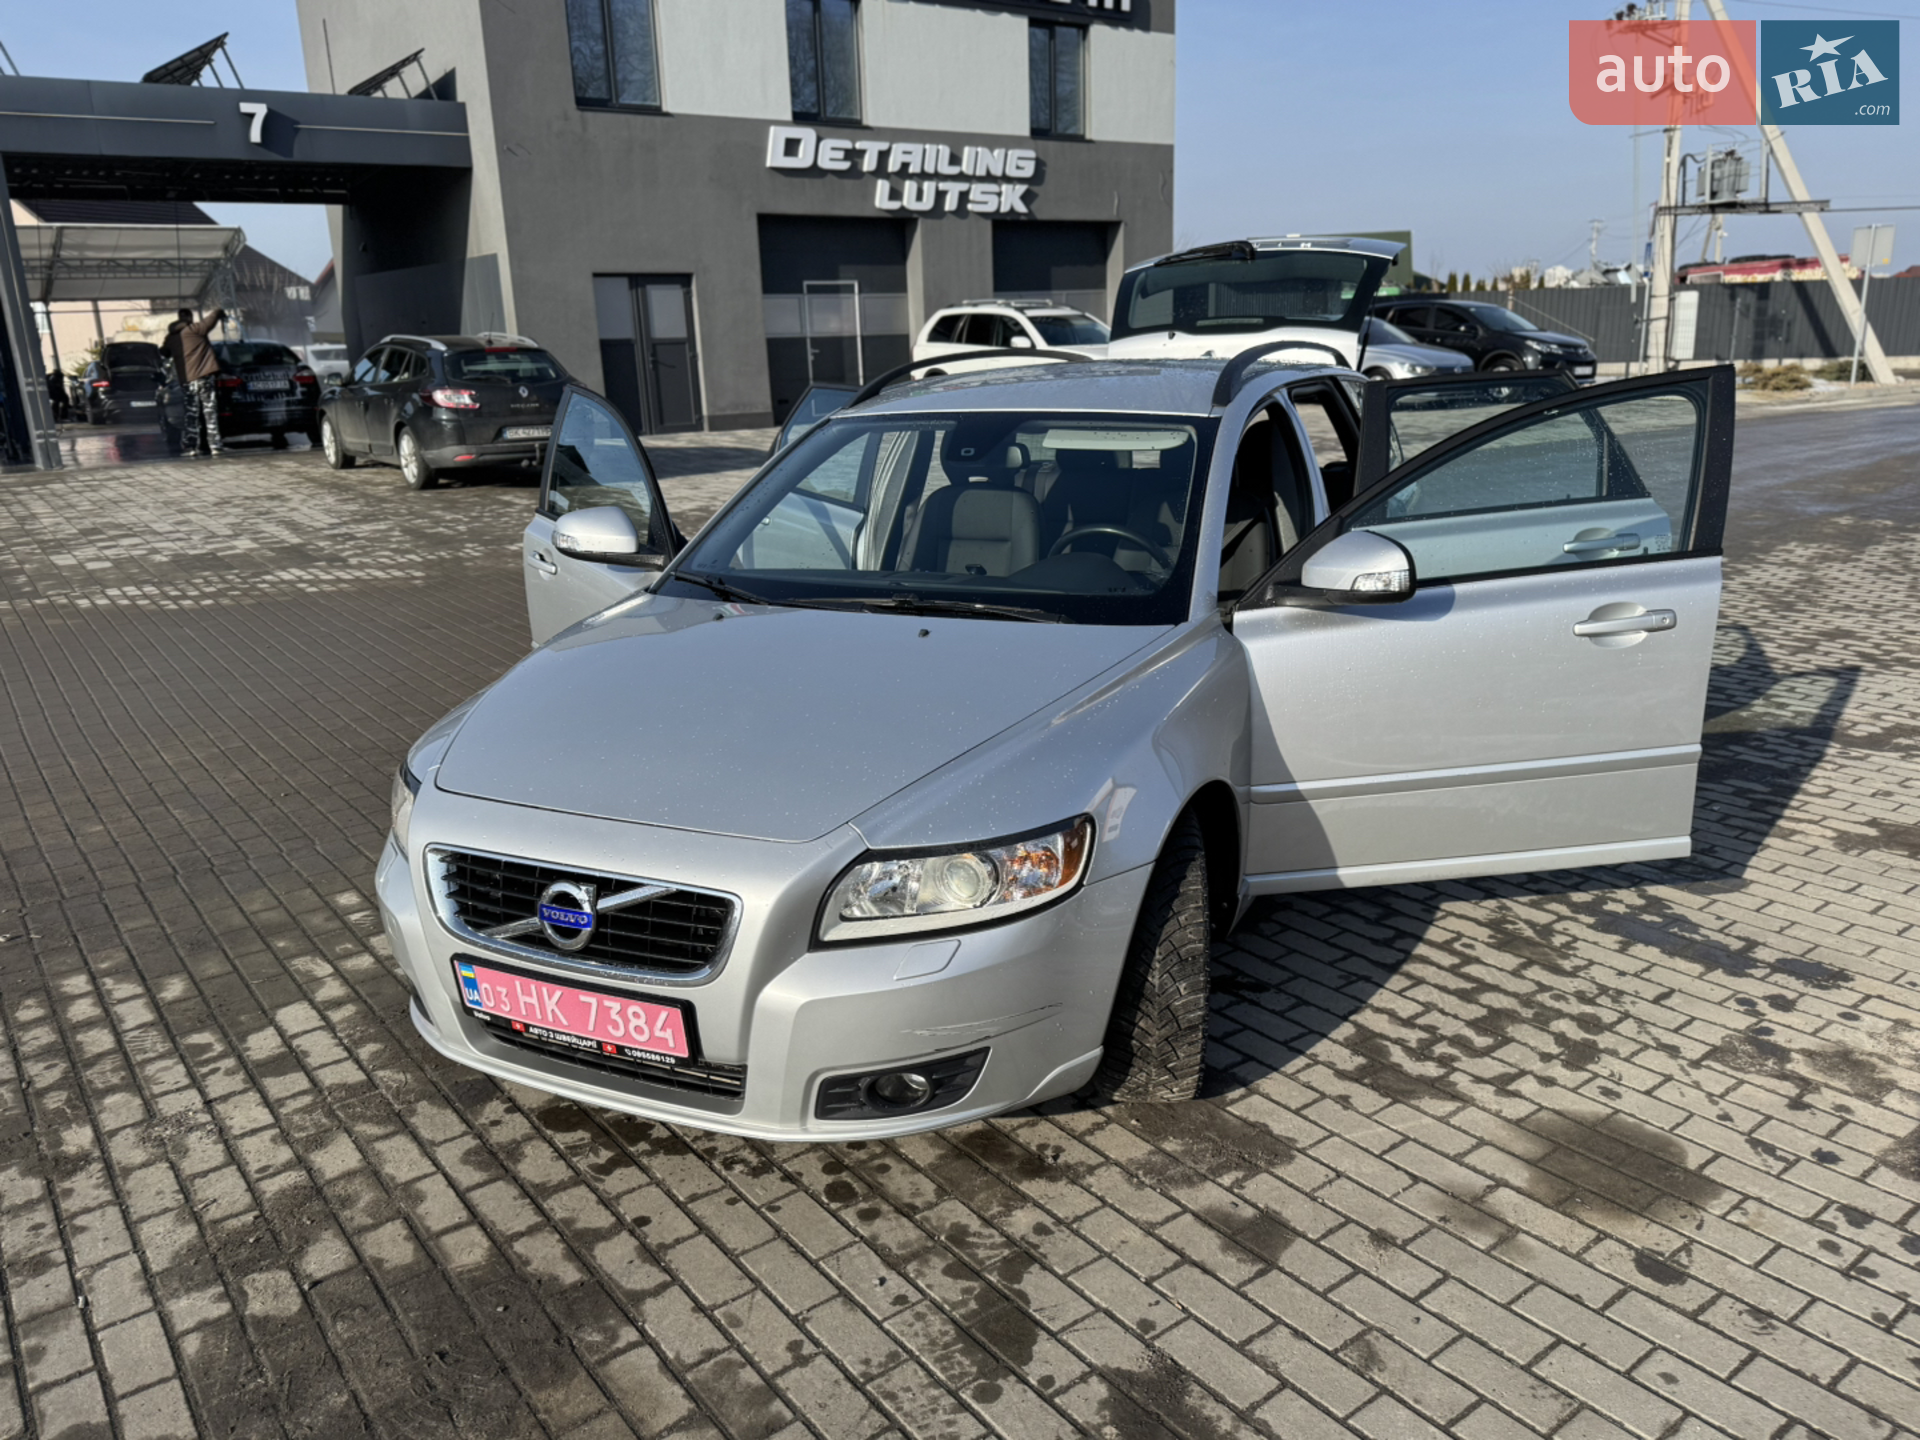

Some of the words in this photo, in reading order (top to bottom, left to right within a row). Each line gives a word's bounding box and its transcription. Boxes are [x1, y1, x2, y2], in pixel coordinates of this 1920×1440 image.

[238, 102, 268, 143] 7
[766, 125, 1037, 178] DETAILING
[875, 179, 1029, 214] LUTSK
[542, 907, 588, 925] VOLVO
[465, 987, 481, 1002] UA
[481, 982, 512, 1013] 03
[515, 980, 570, 1027] HK
[579, 994, 677, 1049] 7384
